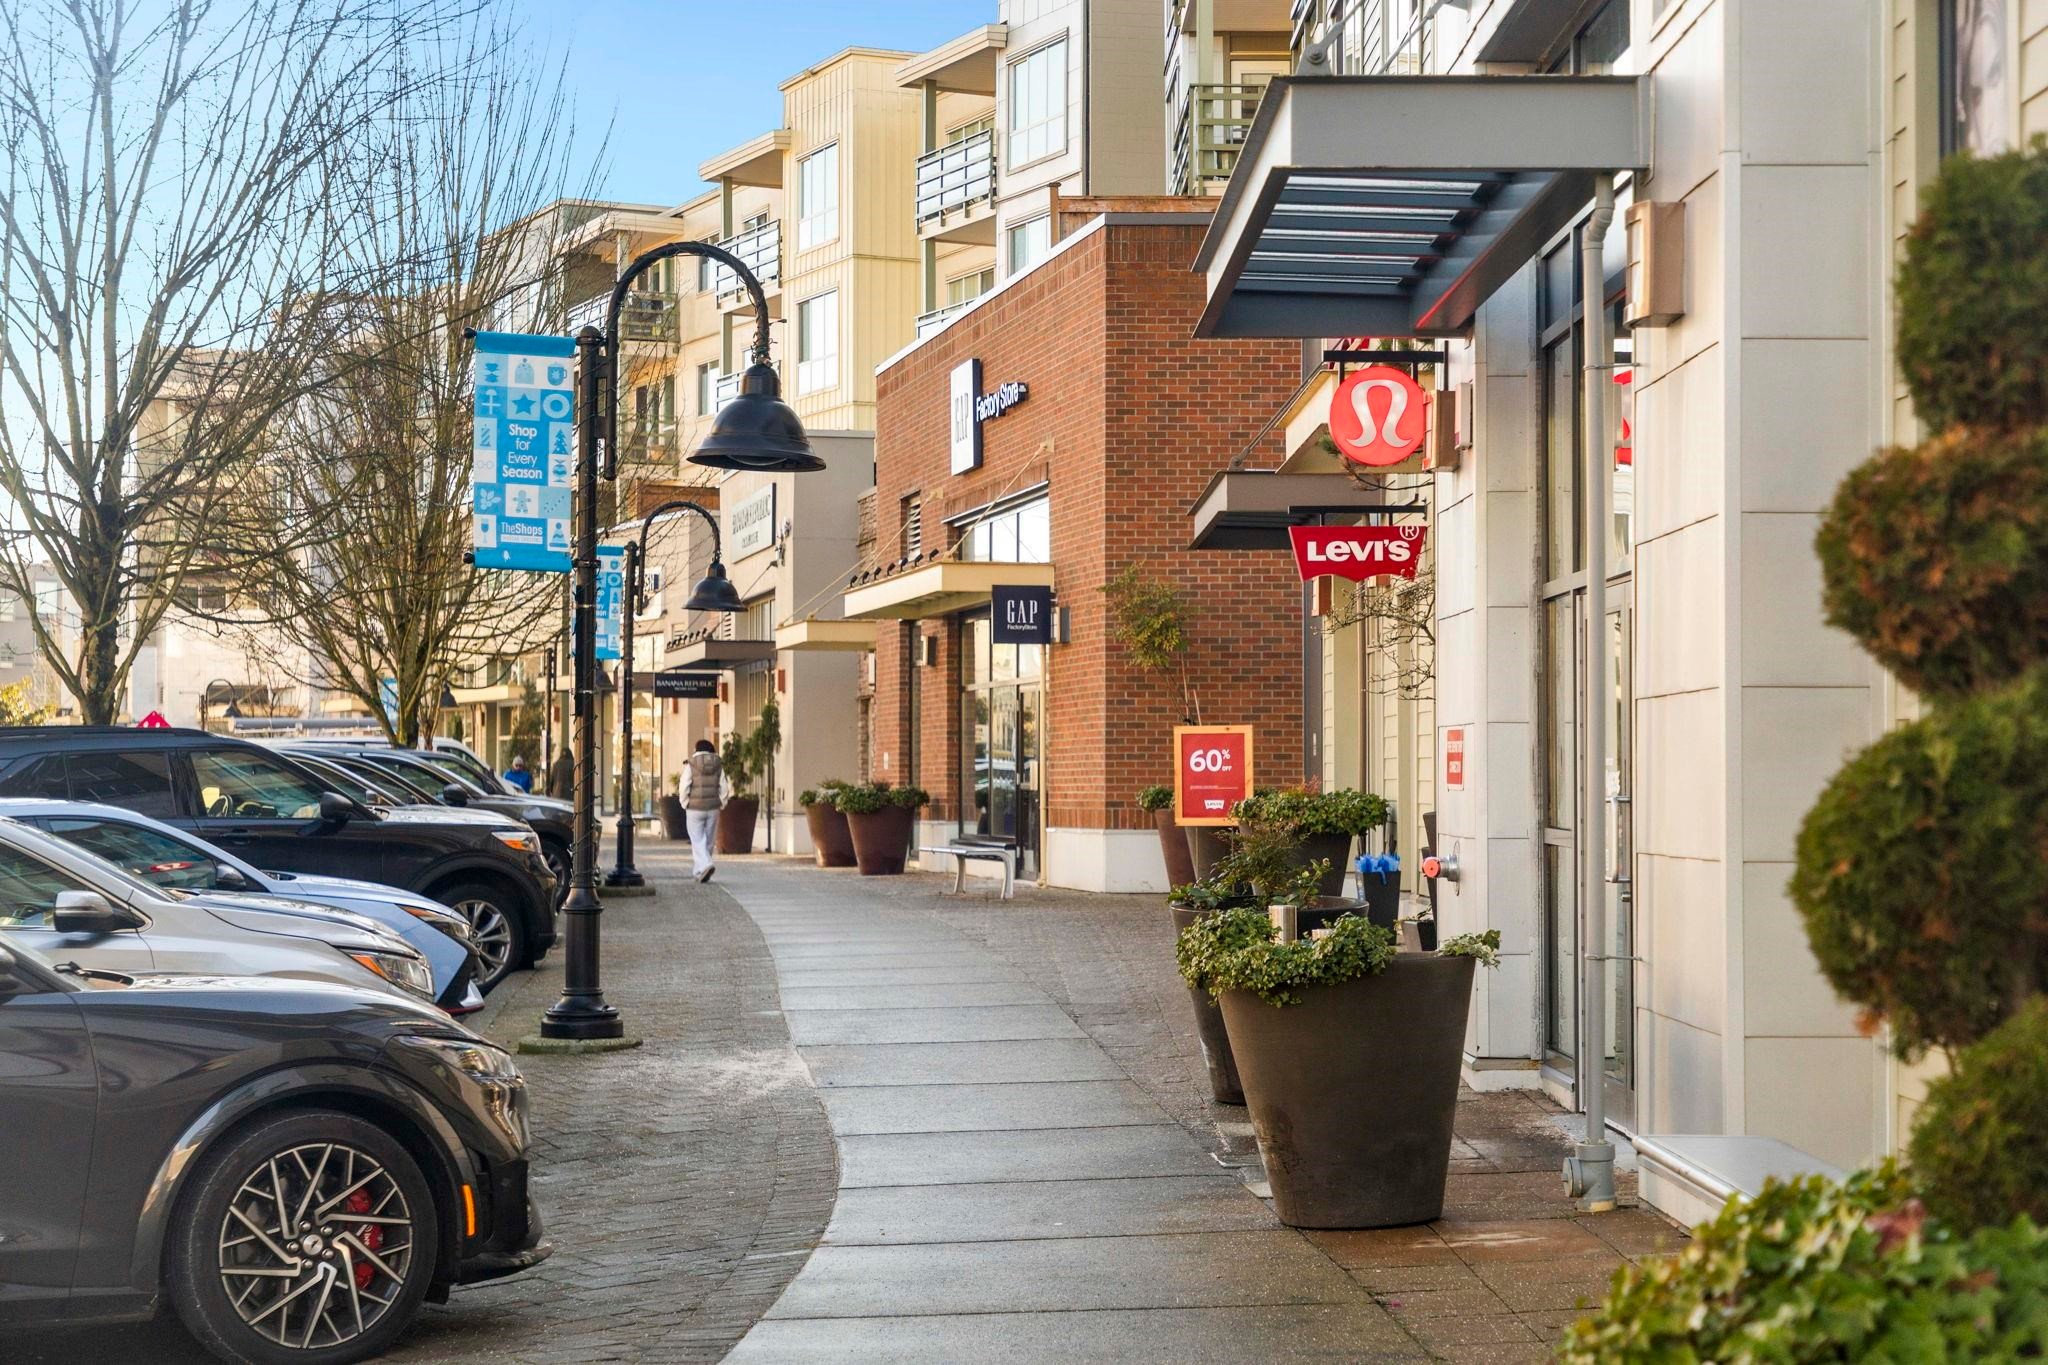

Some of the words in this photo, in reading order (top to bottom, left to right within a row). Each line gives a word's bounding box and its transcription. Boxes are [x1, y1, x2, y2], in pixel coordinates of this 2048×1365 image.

[976, 391, 1000, 422] Factory
[1000, 382, 1019, 410] Store
[508, 423, 538, 439] Shop
[515, 437, 535, 450] for
[508, 451, 538, 468] Every
[502, 464, 543, 479] Season
[1007, 599, 1038, 624] GAP
